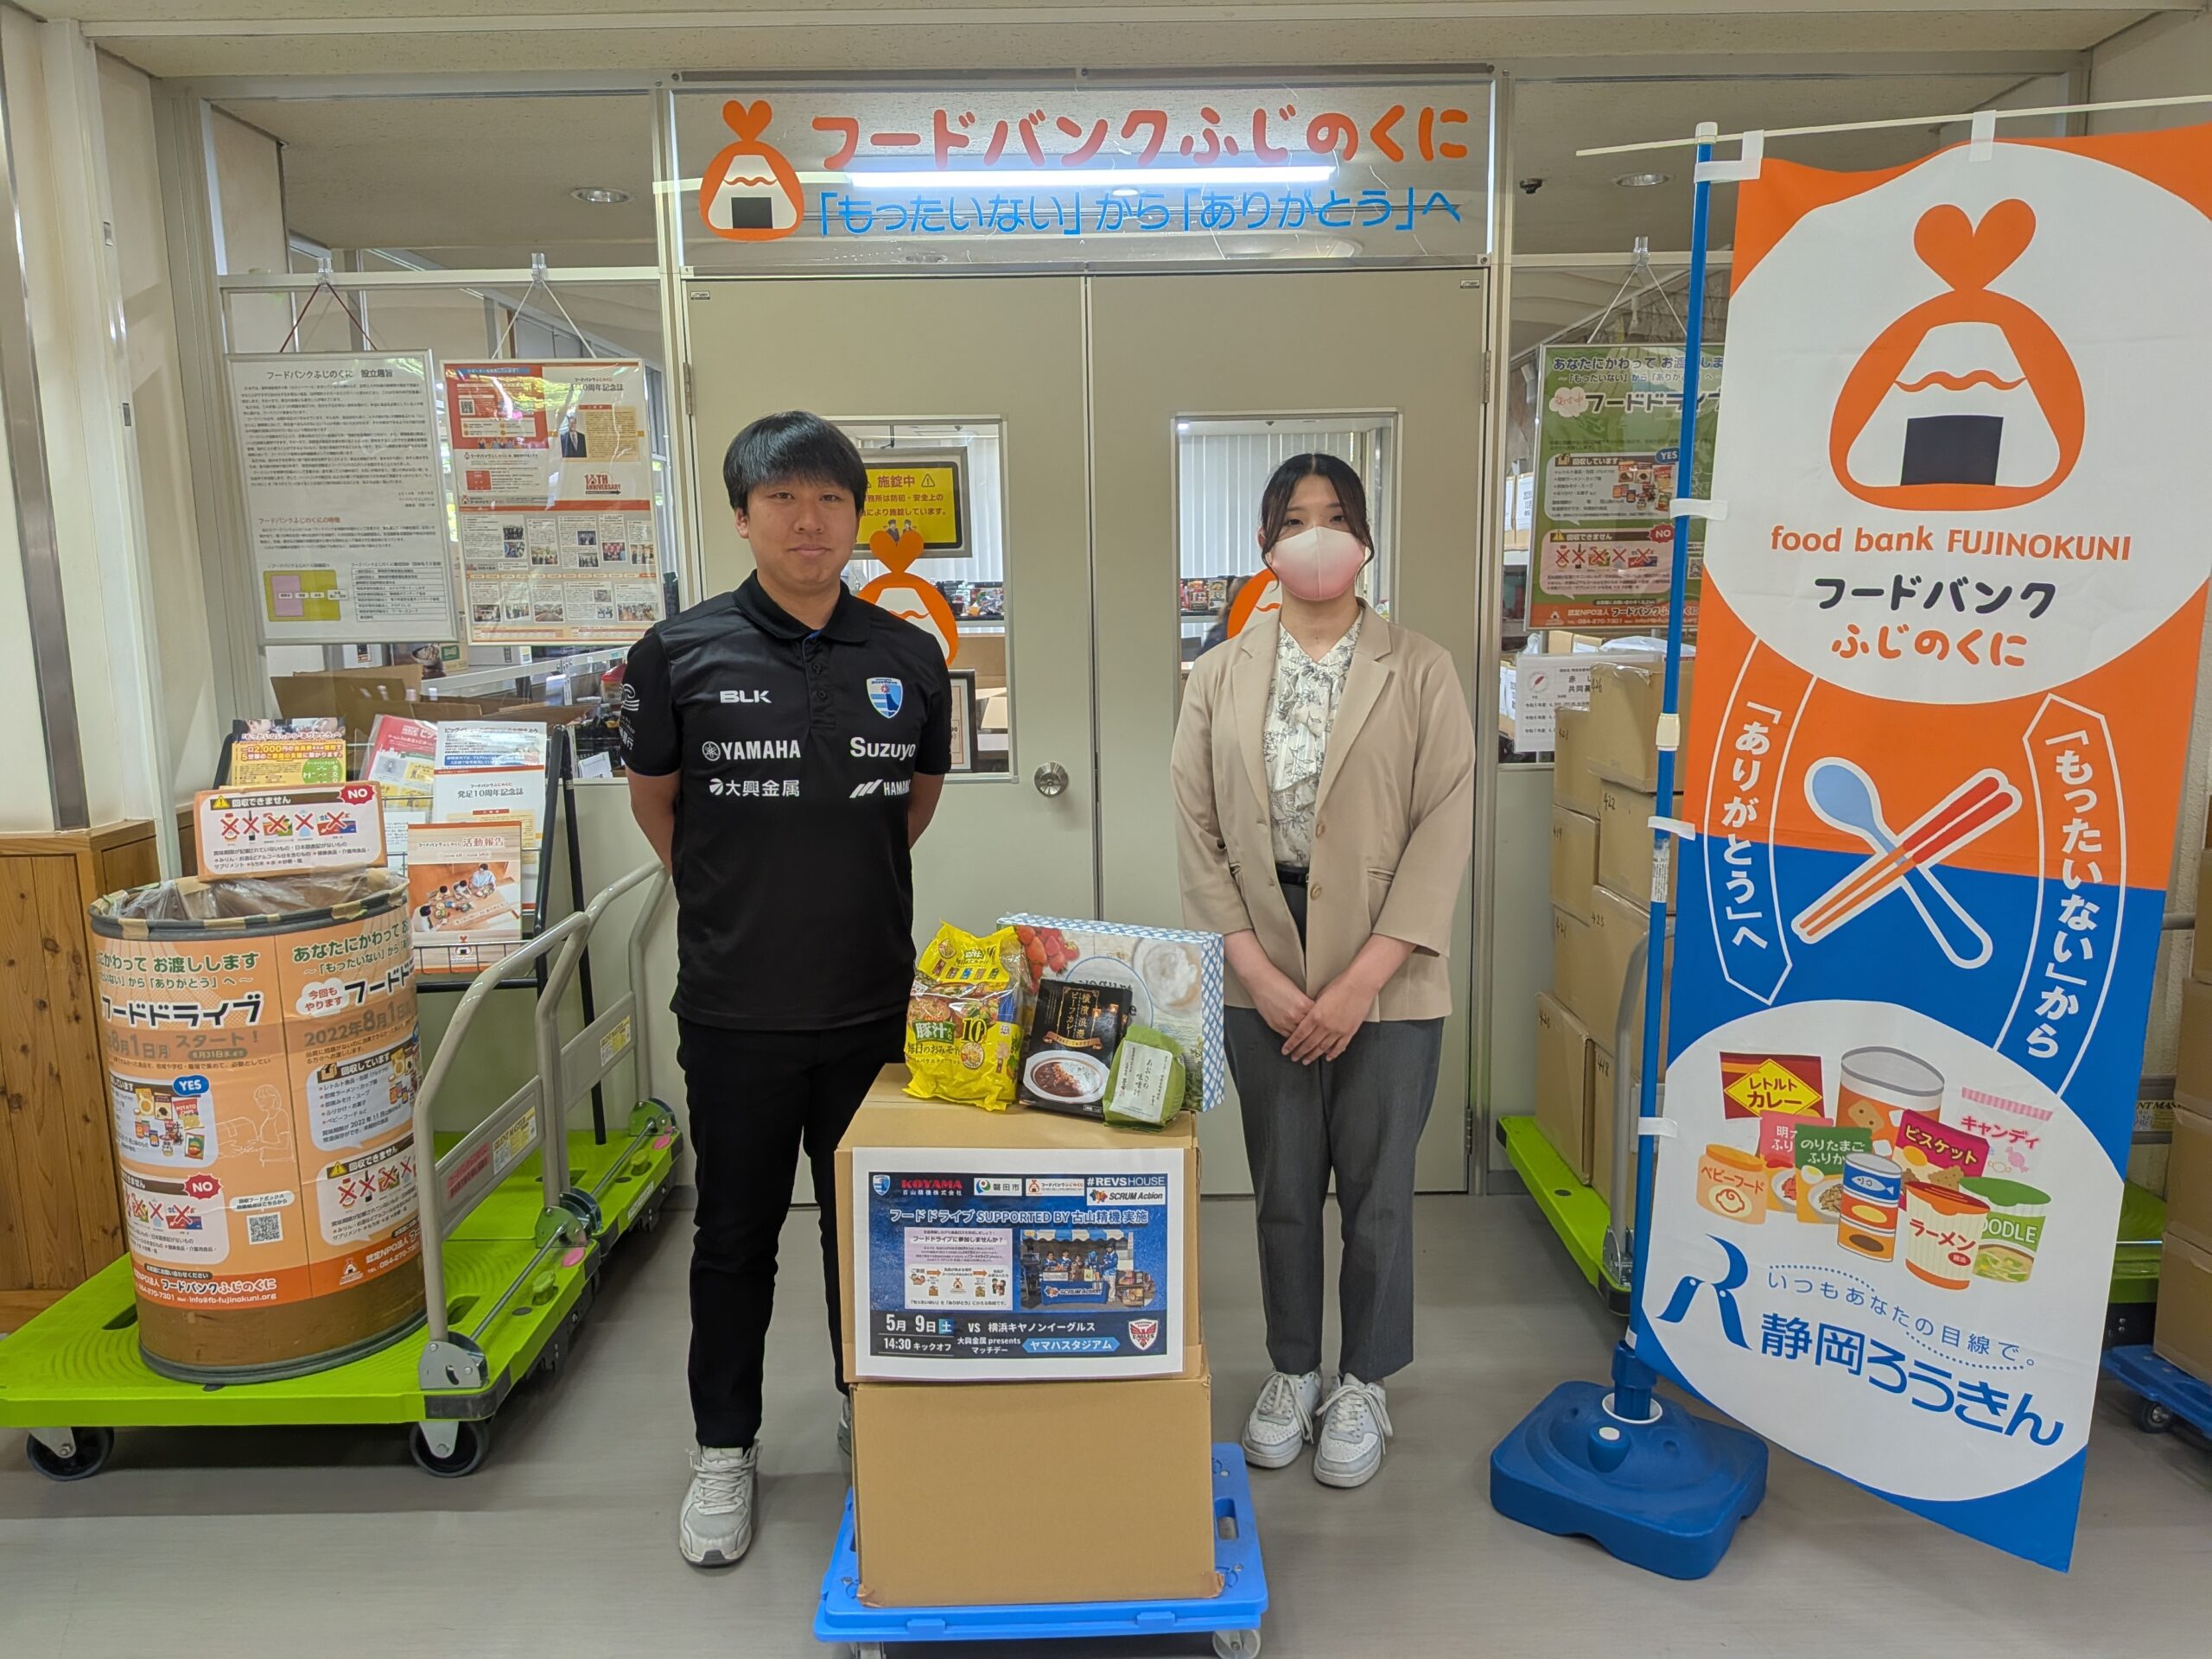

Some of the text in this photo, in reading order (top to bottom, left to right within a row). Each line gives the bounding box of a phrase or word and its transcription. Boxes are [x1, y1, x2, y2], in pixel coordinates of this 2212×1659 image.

[812, 104, 1470, 170] フードバンクふじのくに
[1554, 357, 1656, 371] あなたにかわって
[266, 369, 353, 380] フードバンクふじのくに
[1572, 457, 1618, 466] 回収しています
[1660, 450, 1678, 460] YES
[877, 475, 916, 488] 施錠中
[1655, 530, 1671, 538] NO
[1771, 524, 2132, 561] food bank FUJINOKUNI
[1815, 574, 2056, 620] フードバンク
[1830, 623, 2028, 668] ふじのくに
[720, 690, 772, 704] BLK
[721, 741, 802, 760] YAMAHA
[849, 736, 917, 761] Suzuyo
[347, 788, 368, 799] NO
[457, 788, 524, 798] 発足10周年記念誌
[725, 779, 801, 798] 大興金属
[231, 795, 291, 808] 回収できません
[1603, 792, 1616, 810] 422
[1720, 700, 1783, 950] 「ありがとう」へ
[462, 836, 504, 847] 活動報告
[2025, 728, 2104, 1059] 「もったいない」から
[292, 923, 400, 963] あなたにかわって
[153, 952, 260, 973] お渡しします
[129, 976, 145, 988] から
[149, 976, 217, 989] 「ありがとう」
[308, 987, 338, 1001] 今回も
[102, 993, 262, 1027] フードドライブ
[304, 995, 343, 1012] やります
[916, 1024, 947, 1039] 豚汁
[961, 1018, 987, 1043] 10
[907, 1042, 961, 1056] 毎日のおみそ汁
[340, 1052, 391, 1077] 回収しています
[178, 1079, 202, 1091] YES
[1749, 1077, 1798, 1092] レトルト
[1746, 1090, 1802, 1109] カレー
[350, 1118, 366, 1128] 2022
[1961, 1116, 2040, 1150] キャンディ
[1801, 1139, 1866, 1154] のりたまご
[1904, 1124, 1979, 1166] ビスケット
[348, 1146, 399, 1173] 回収できません
[192, 1181, 213, 1192] NO
[900, 1179, 963, 1190] KOYAMA
[993, 1183, 1020, 1192] 磐田市
[1087, 1177, 1166, 1186] #REVSHOUSE
[1700, 1166, 1765, 1195] ベビーフード
[1109, 1192, 1163, 1201] SCRUM Action
[889, 1209, 1148, 1224] フードドライブ SUPPORTED BY 古山精機 実施
[1909, 1217, 1977, 1252] ラーメン
[161, 1278, 277, 1294] フードバンクふじのくに
[188, 1292, 277, 1304] info@fb-fujinokuni.org
[886, 1313, 952, 1333] 5月 9日 土
[968, 1322, 1096, 1333] VS 横浜キヤノンイーグルス
[1768, 1272, 2037, 1368] いつもあなたの目線で。
[883, 1338, 952, 1352] 14:30 キックオフ
[988, 1337, 1021, 1345] presents
[1029, 1340, 1113, 1351] ヤマハスタジアム
[971, 1346, 1008, 1355] マッチデー
[1760, 1312, 2065, 1448] 静岡ろうきん
